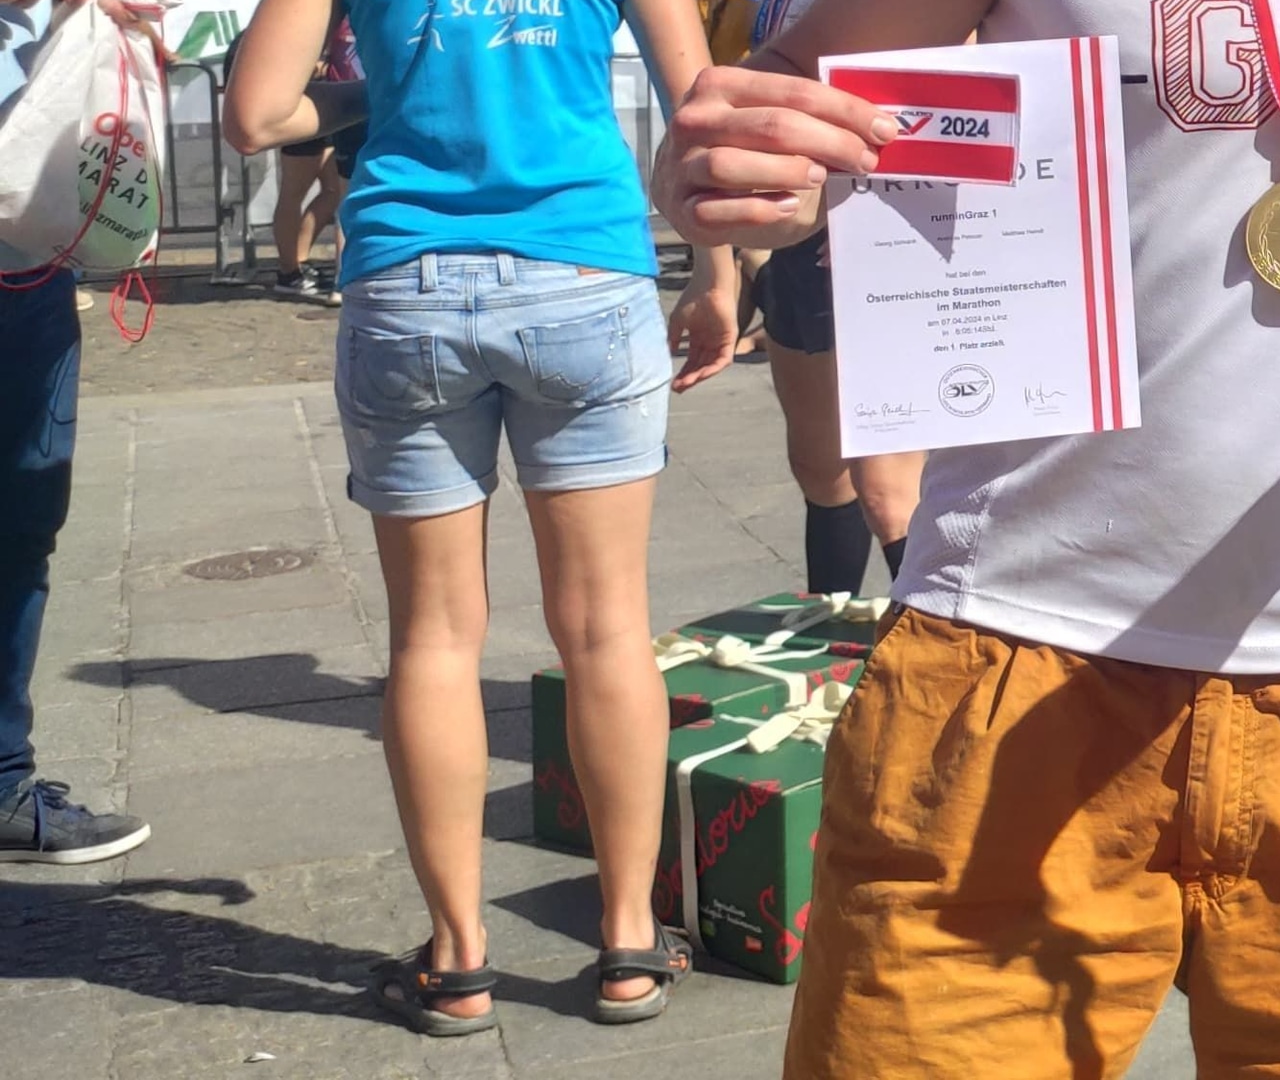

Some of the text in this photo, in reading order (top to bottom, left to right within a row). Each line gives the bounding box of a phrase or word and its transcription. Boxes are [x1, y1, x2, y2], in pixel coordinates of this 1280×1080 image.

[940, 116, 990, 138] 2024
[866, 279, 1066, 303] Österreichische Staatsmeisterschaften
[952, 299, 1001, 310] Marathon
